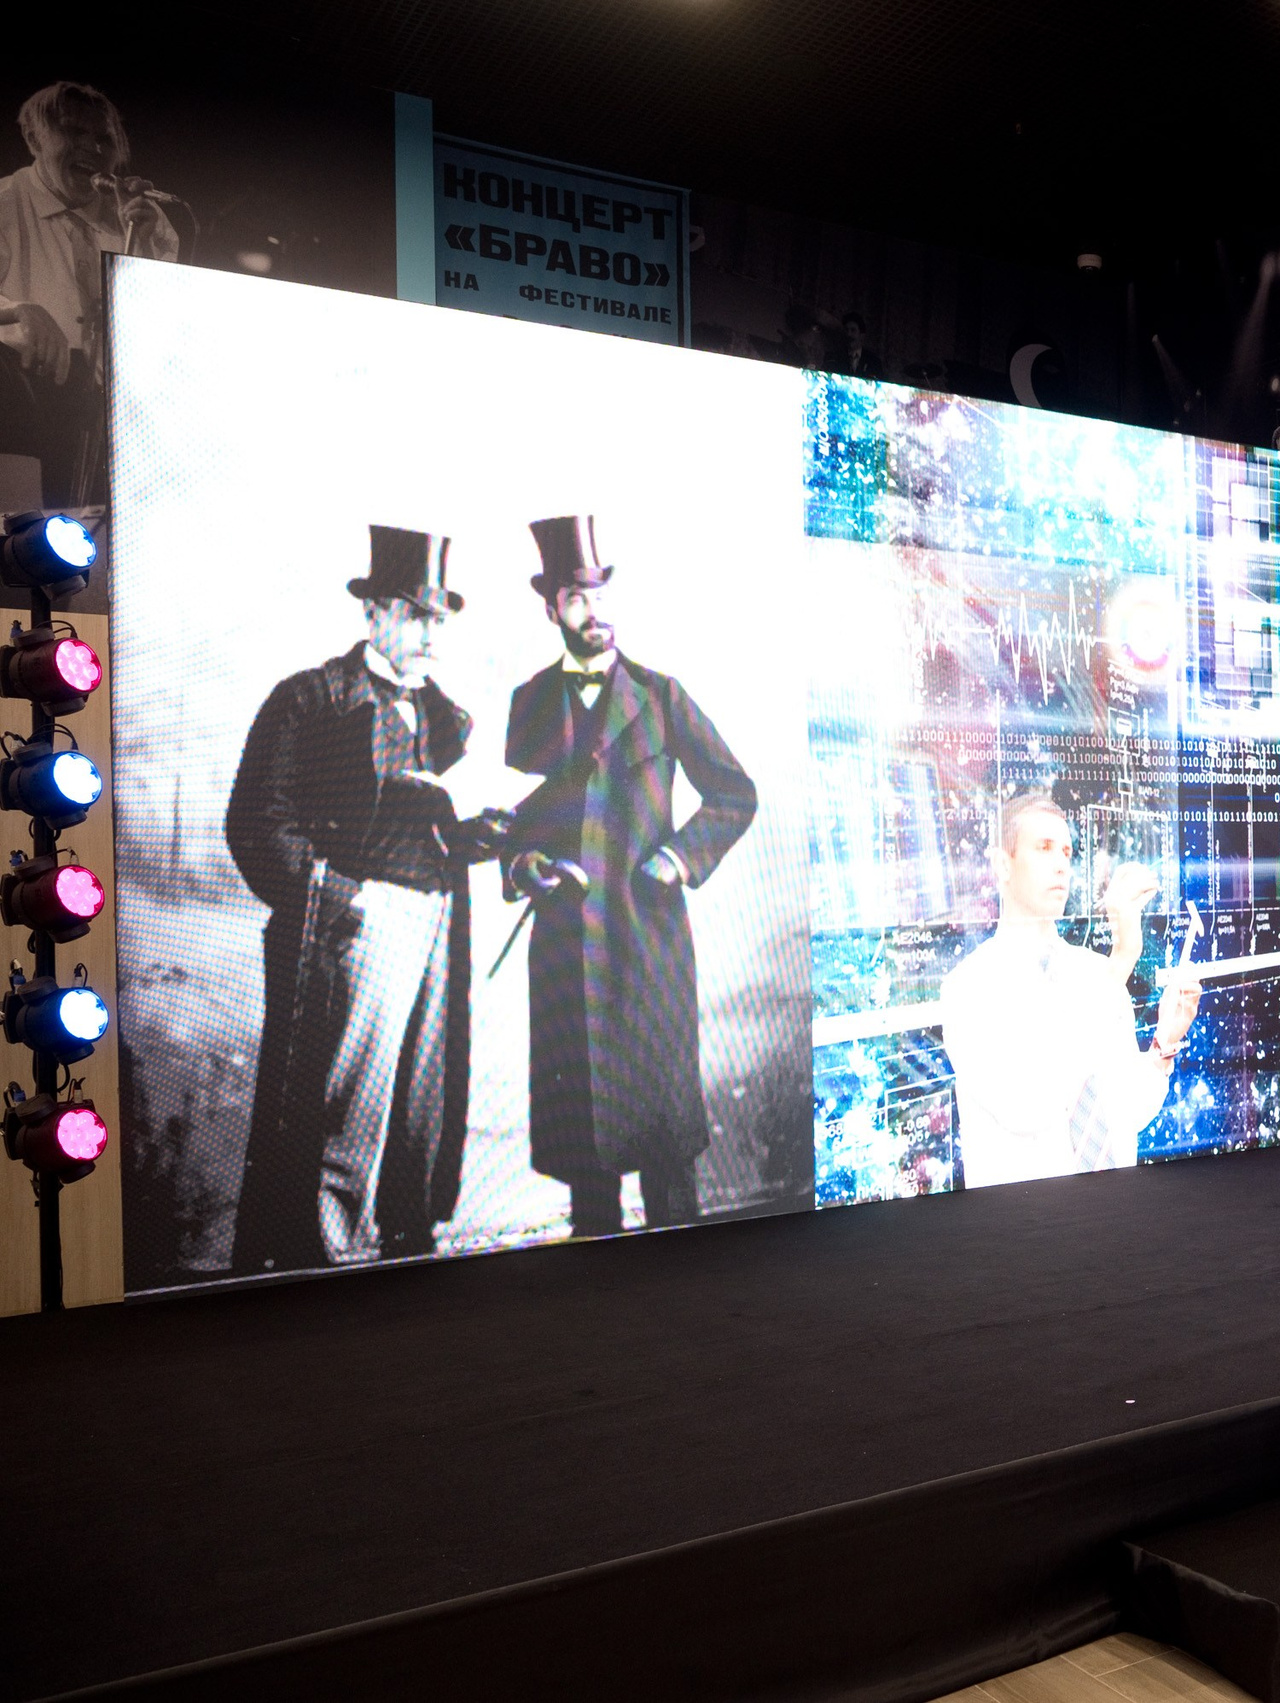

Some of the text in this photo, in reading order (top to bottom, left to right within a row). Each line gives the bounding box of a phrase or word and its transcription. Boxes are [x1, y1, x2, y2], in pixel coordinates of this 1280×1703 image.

[443, 162, 673, 240] КОНЦЕРТ
[444, 223, 671, 287] «БРАВО»
[444, 270, 672, 325] НА ФЕСТИВАЛЕ
